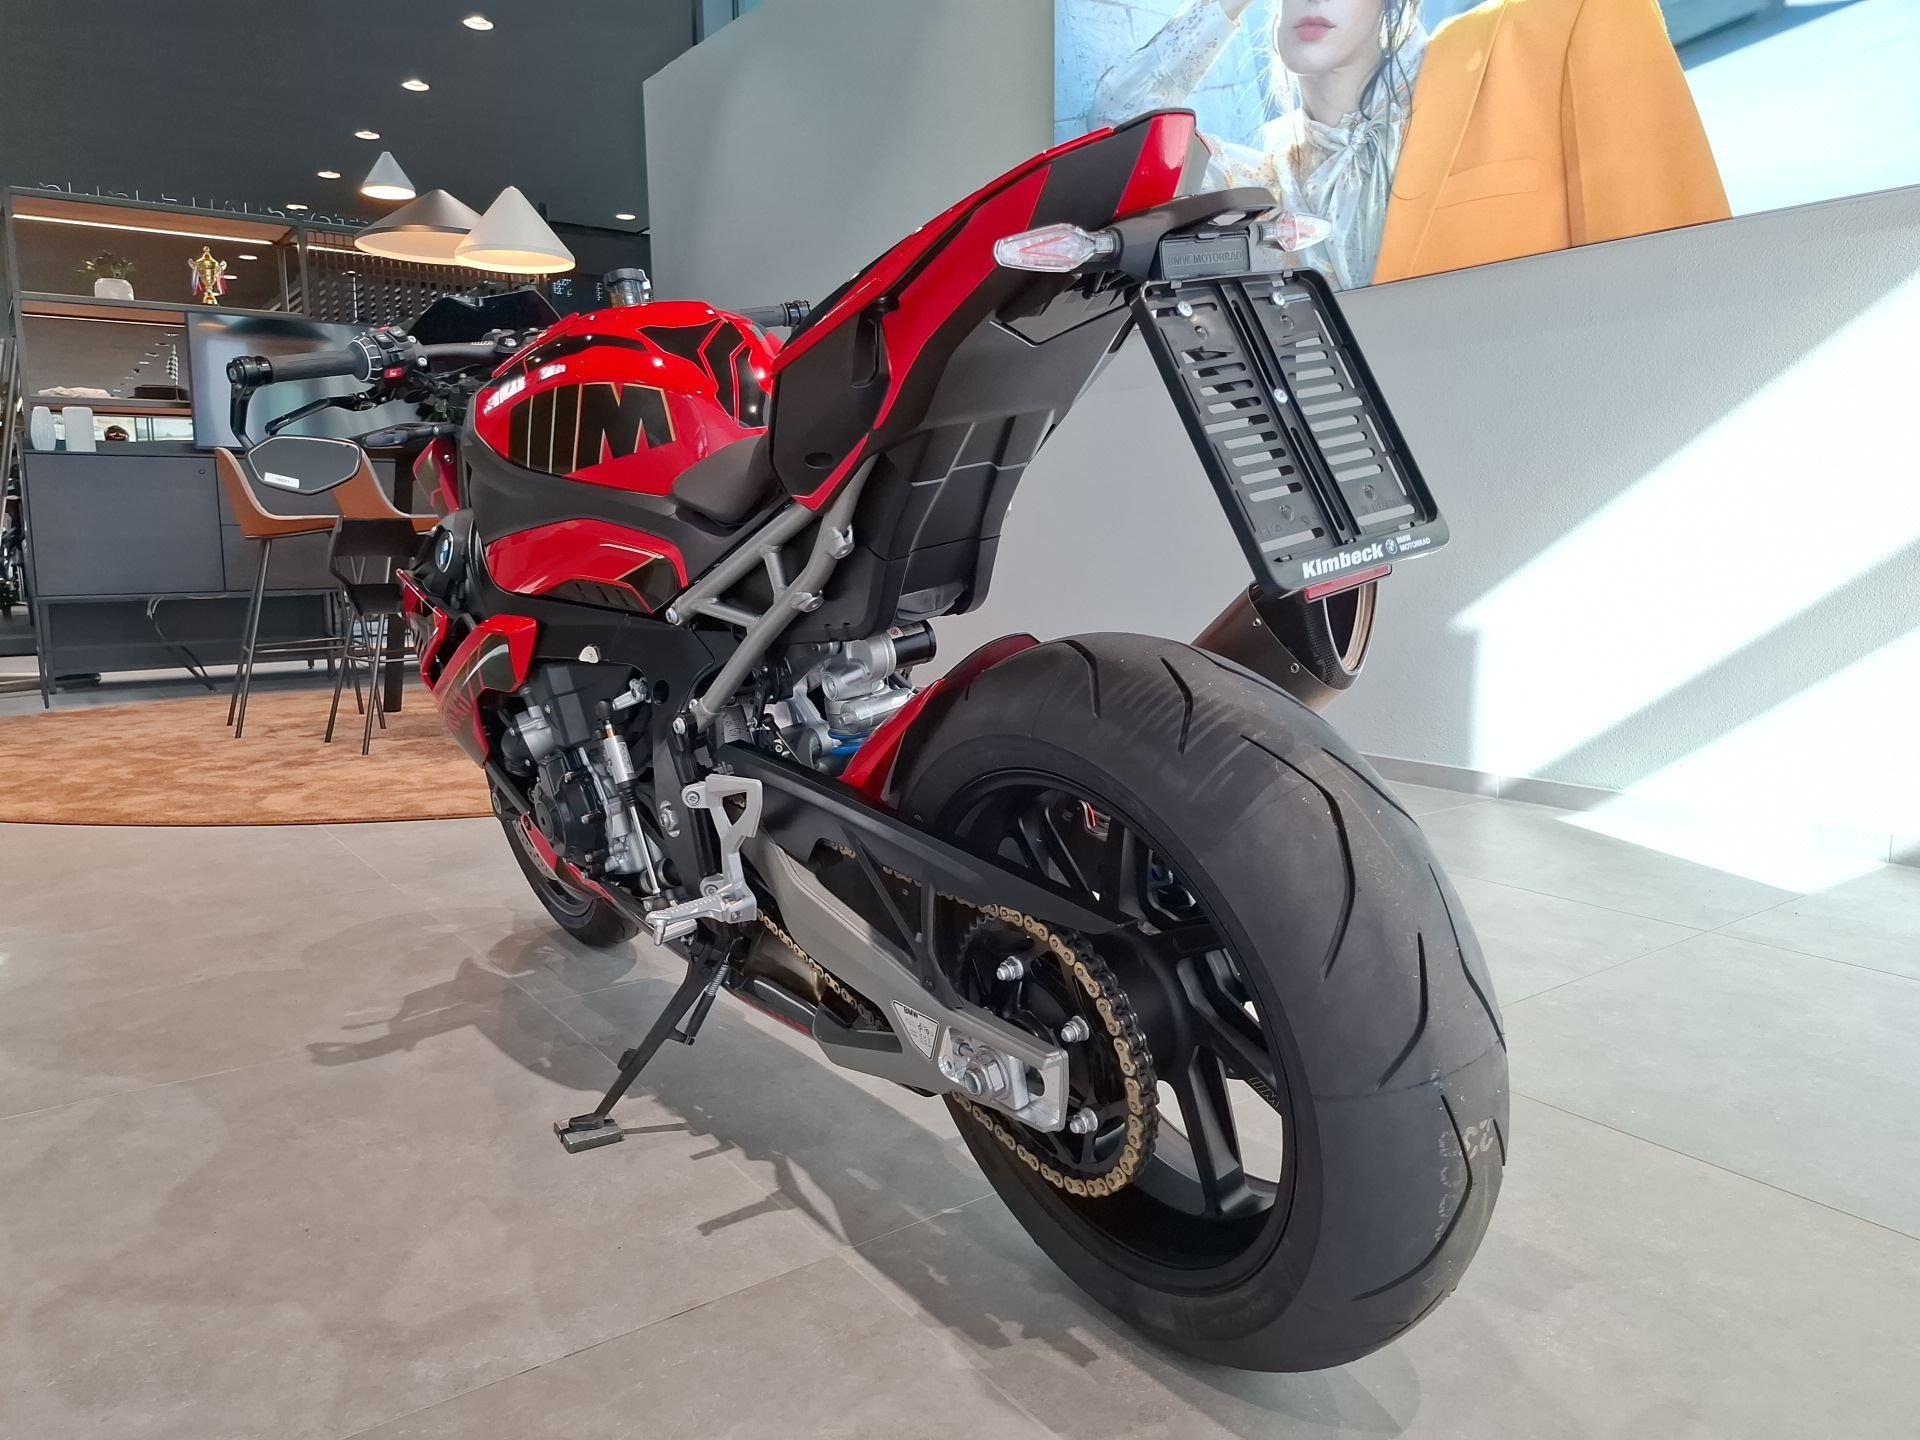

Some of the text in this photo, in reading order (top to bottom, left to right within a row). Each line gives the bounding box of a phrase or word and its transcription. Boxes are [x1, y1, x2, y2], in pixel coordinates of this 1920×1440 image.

[1167, 250, 1242, 266] BMW MOTORRAD
[1396, 534, 1411, 544] BMW
[1399, 537, 1432, 552] MOTORRAD
[1302, 542, 1384, 579] Kimbeck
